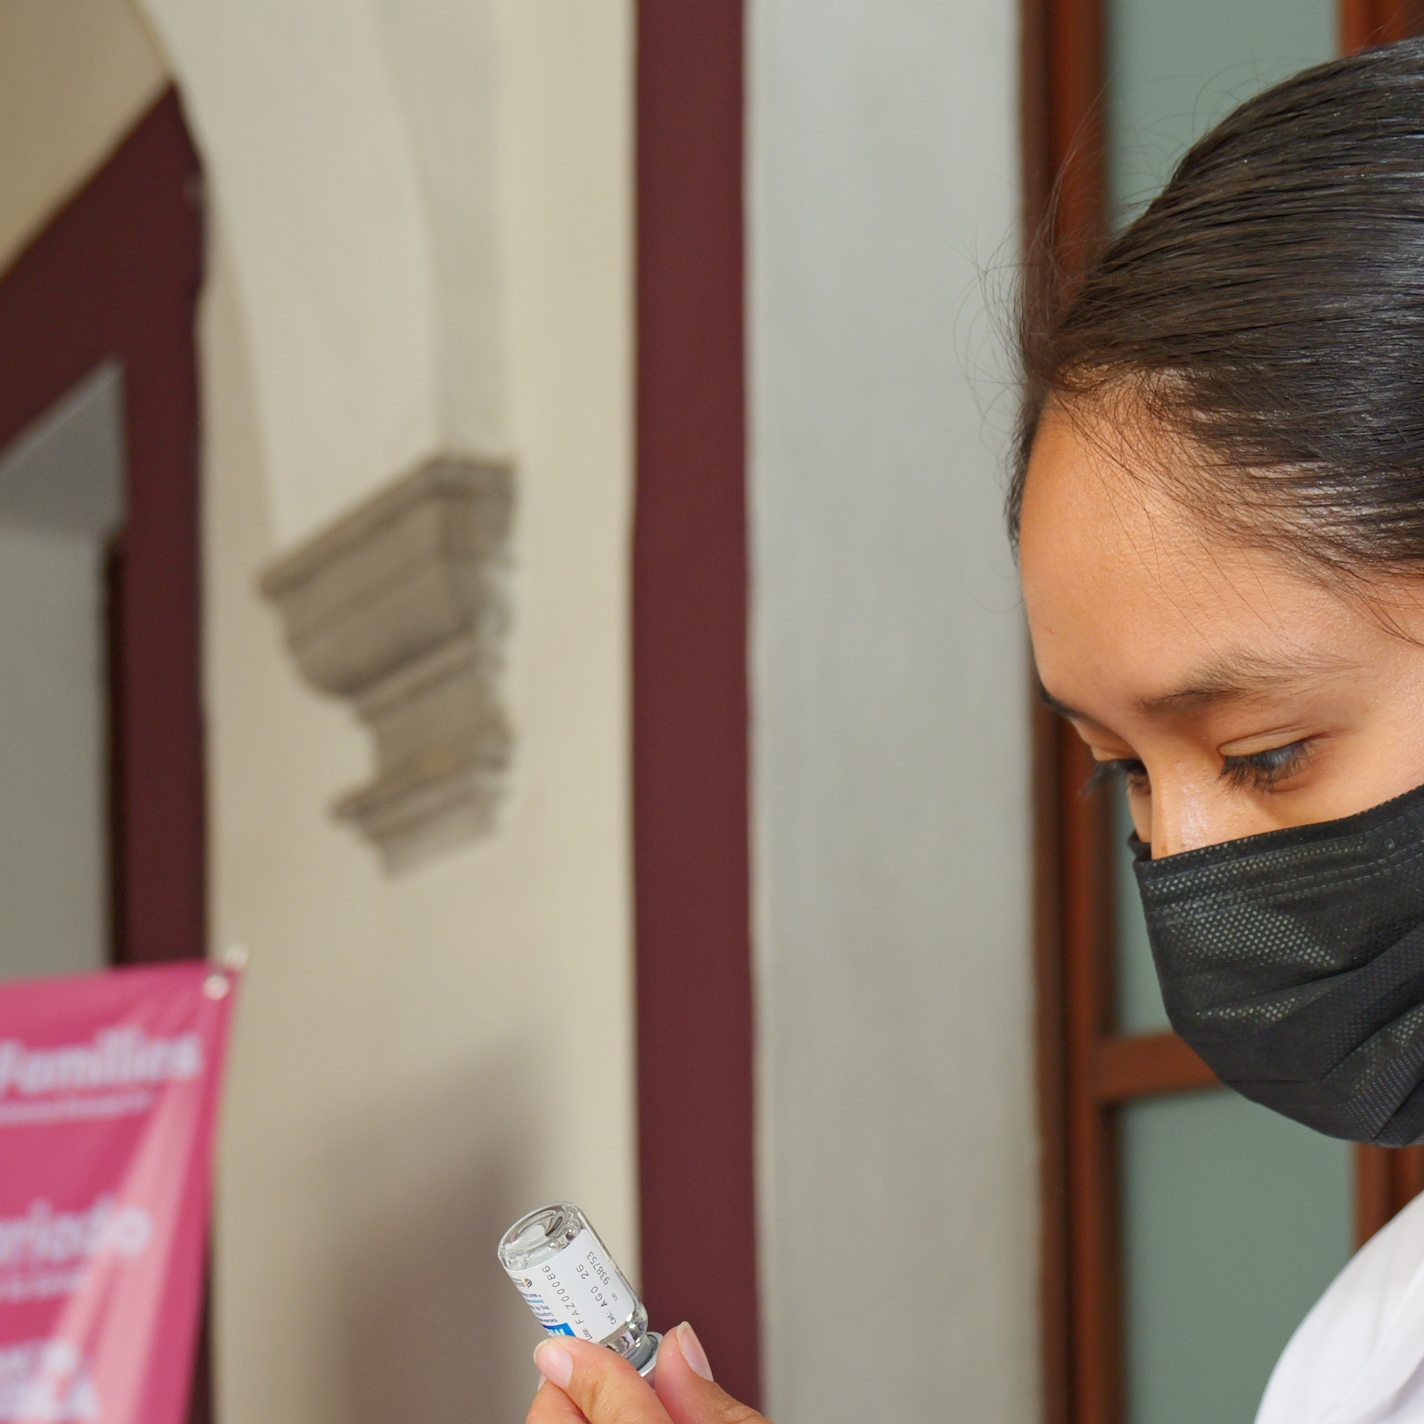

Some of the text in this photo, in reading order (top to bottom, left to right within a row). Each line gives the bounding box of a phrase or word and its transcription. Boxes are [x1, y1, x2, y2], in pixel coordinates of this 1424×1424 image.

[576, 1264, 590, 1280] 26
[587, 1251, 611, 1286] 938753
[542, 1265, 584, 1325] FAZ00086
[590, 1286, 608, 1308] AGO
